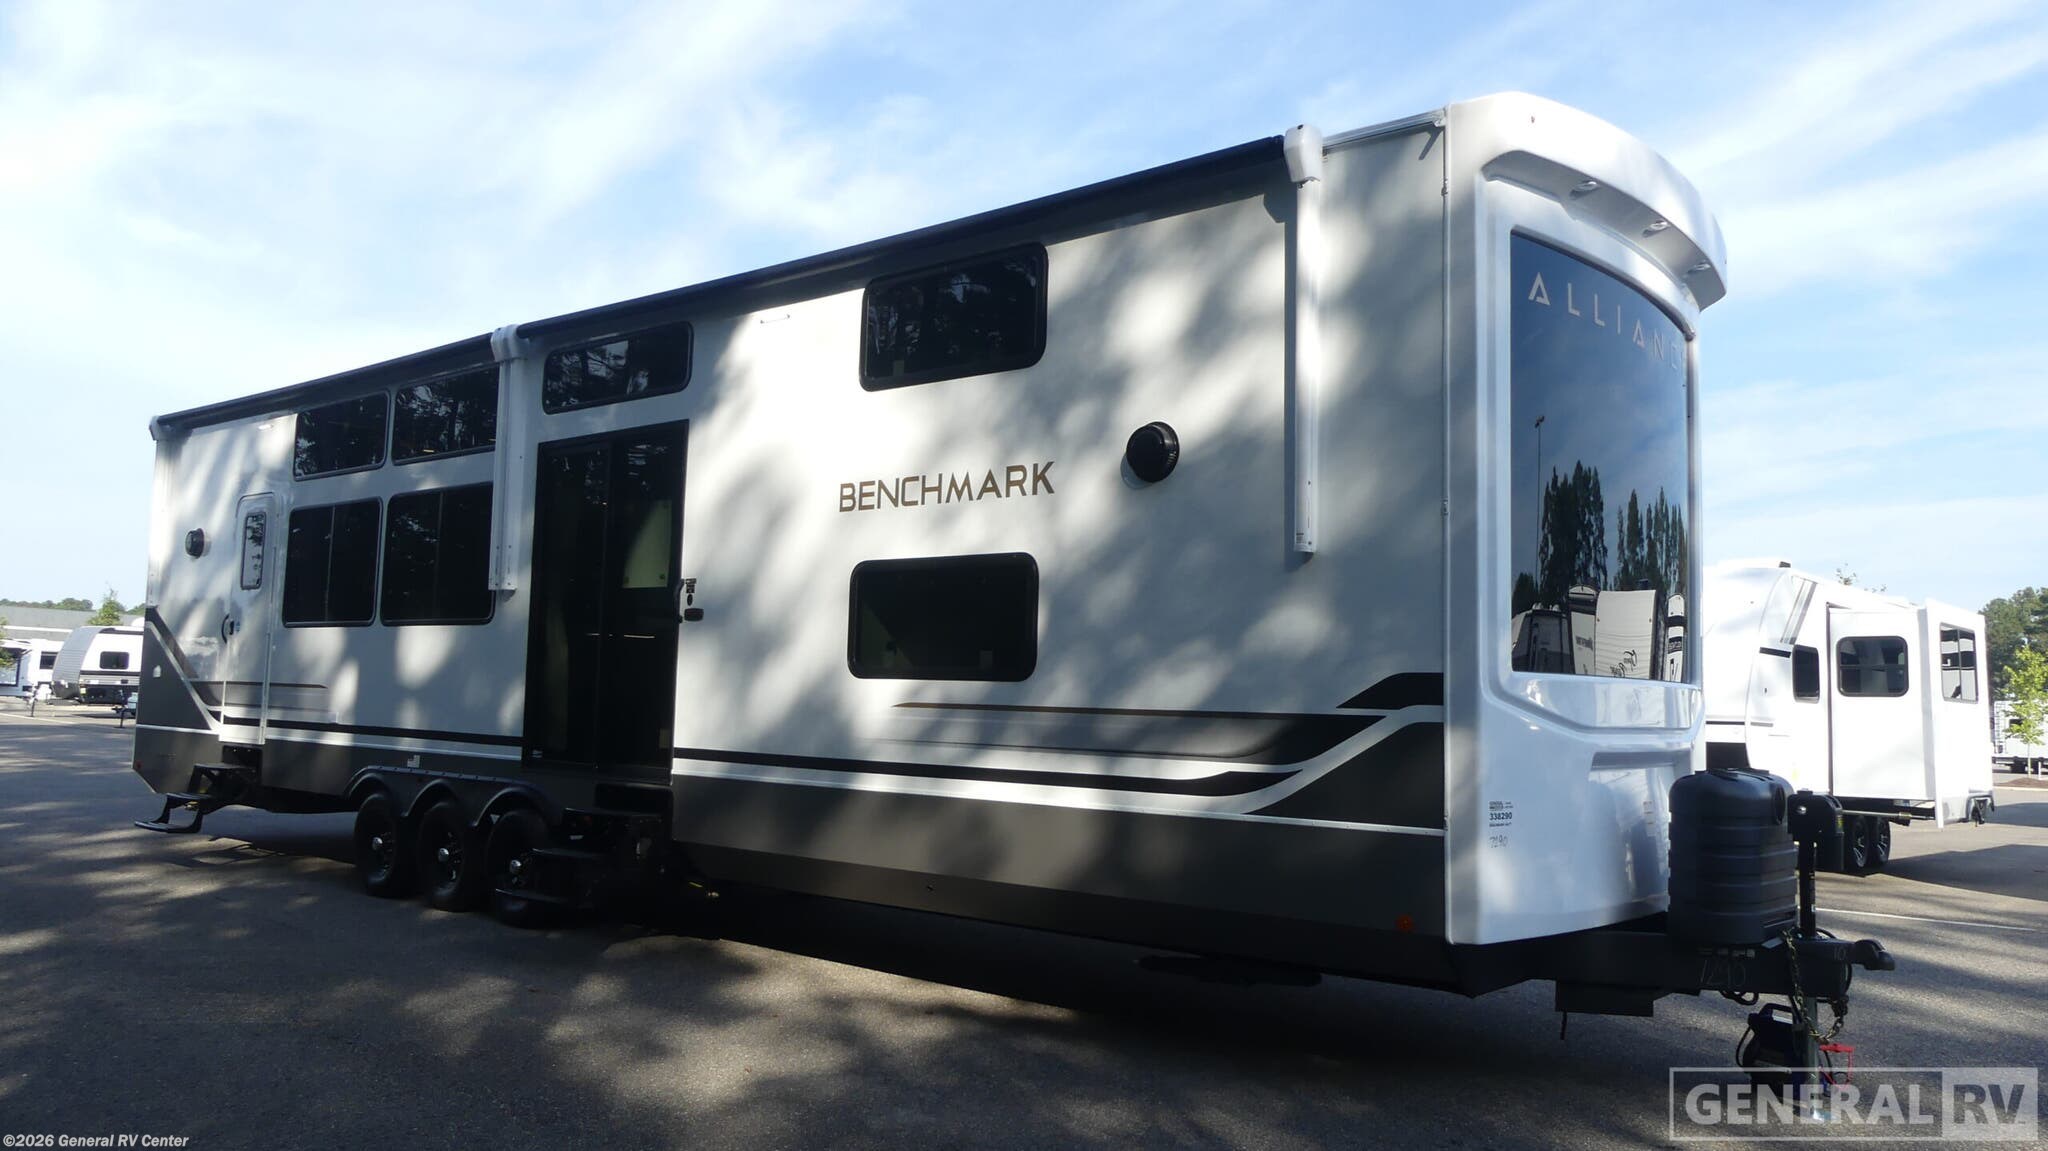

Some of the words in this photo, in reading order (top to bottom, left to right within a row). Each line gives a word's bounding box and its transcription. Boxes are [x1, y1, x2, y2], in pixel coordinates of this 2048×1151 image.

[1528, 272, 1684, 371] ALLIANC
[839, 461, 1055, 512] BENCHMARK
[1489, 811, 1513, 821] 338290
